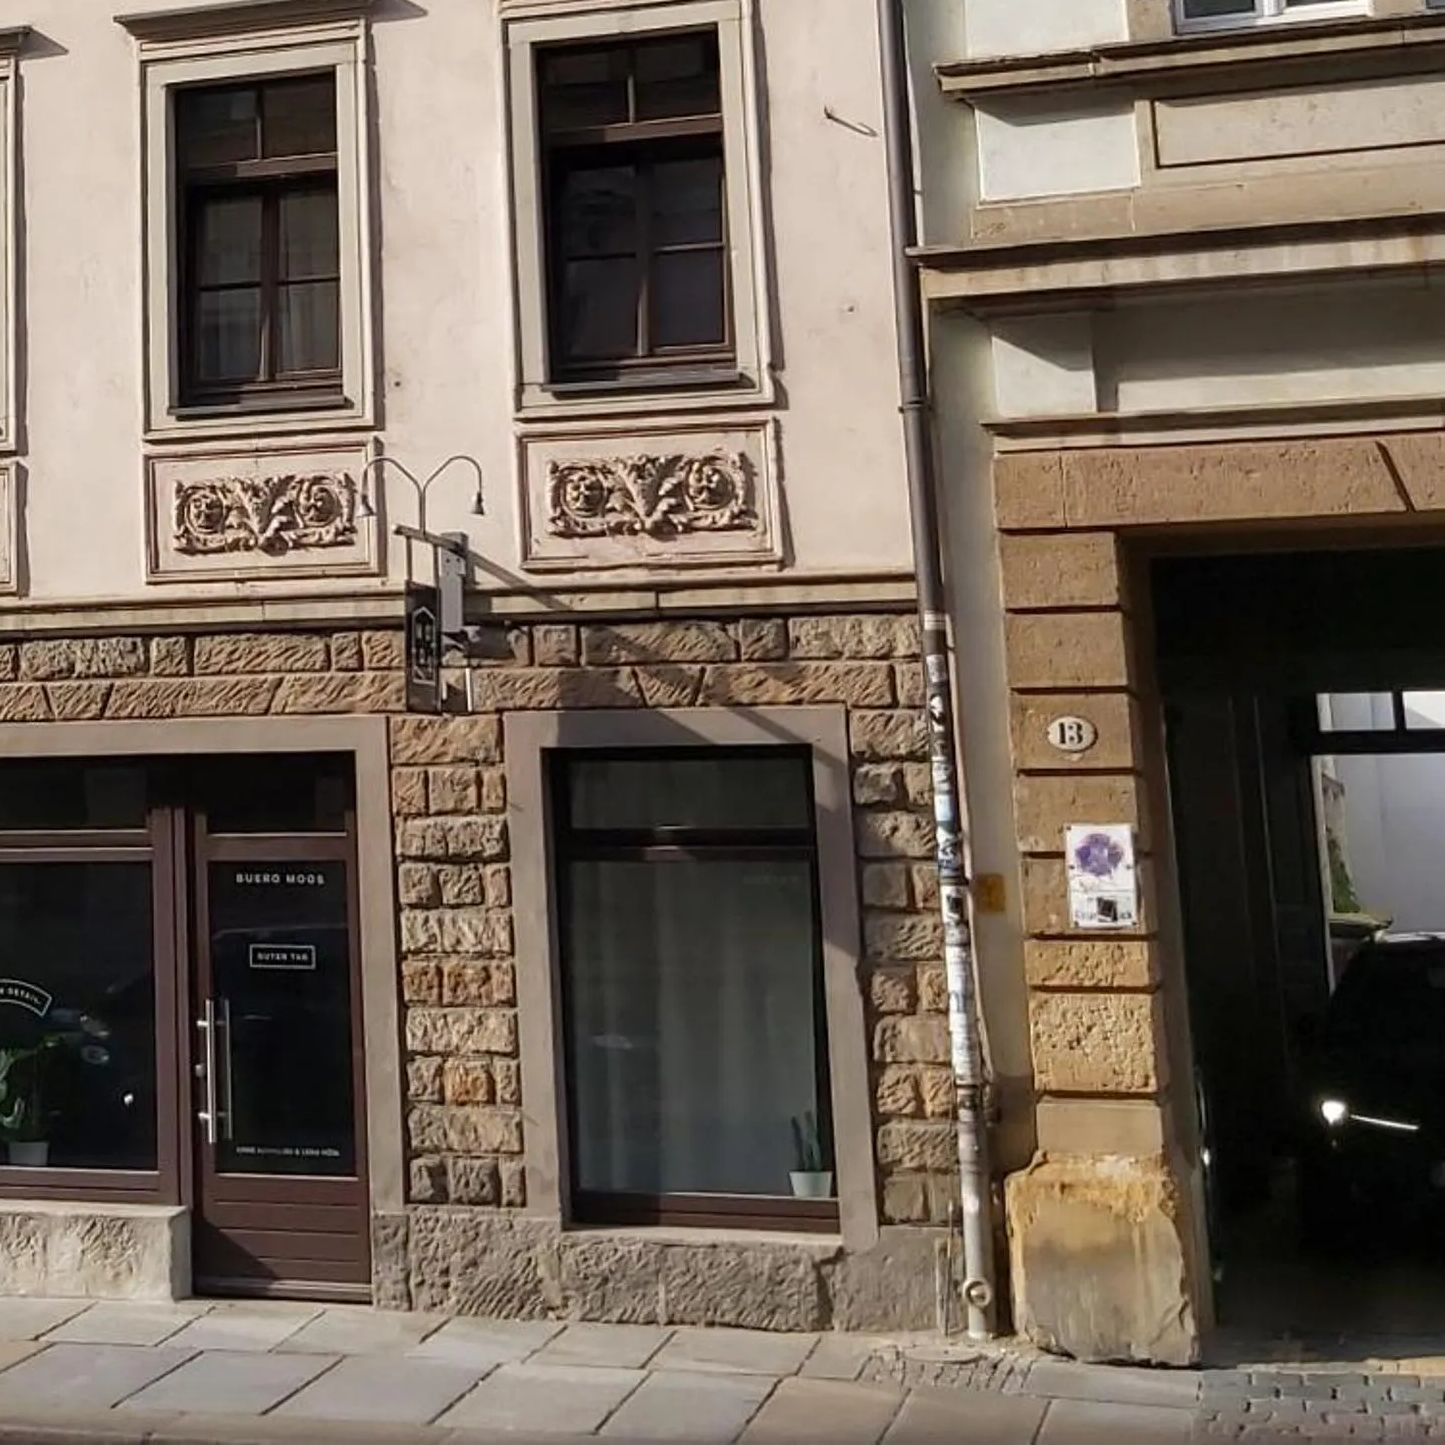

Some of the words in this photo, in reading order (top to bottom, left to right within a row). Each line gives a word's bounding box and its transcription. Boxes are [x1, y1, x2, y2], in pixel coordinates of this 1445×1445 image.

[1057, 721, 1085, 745] 13
[235, 873, 281, 883] BUERO
[285, 873, 326, 885] MOOS
